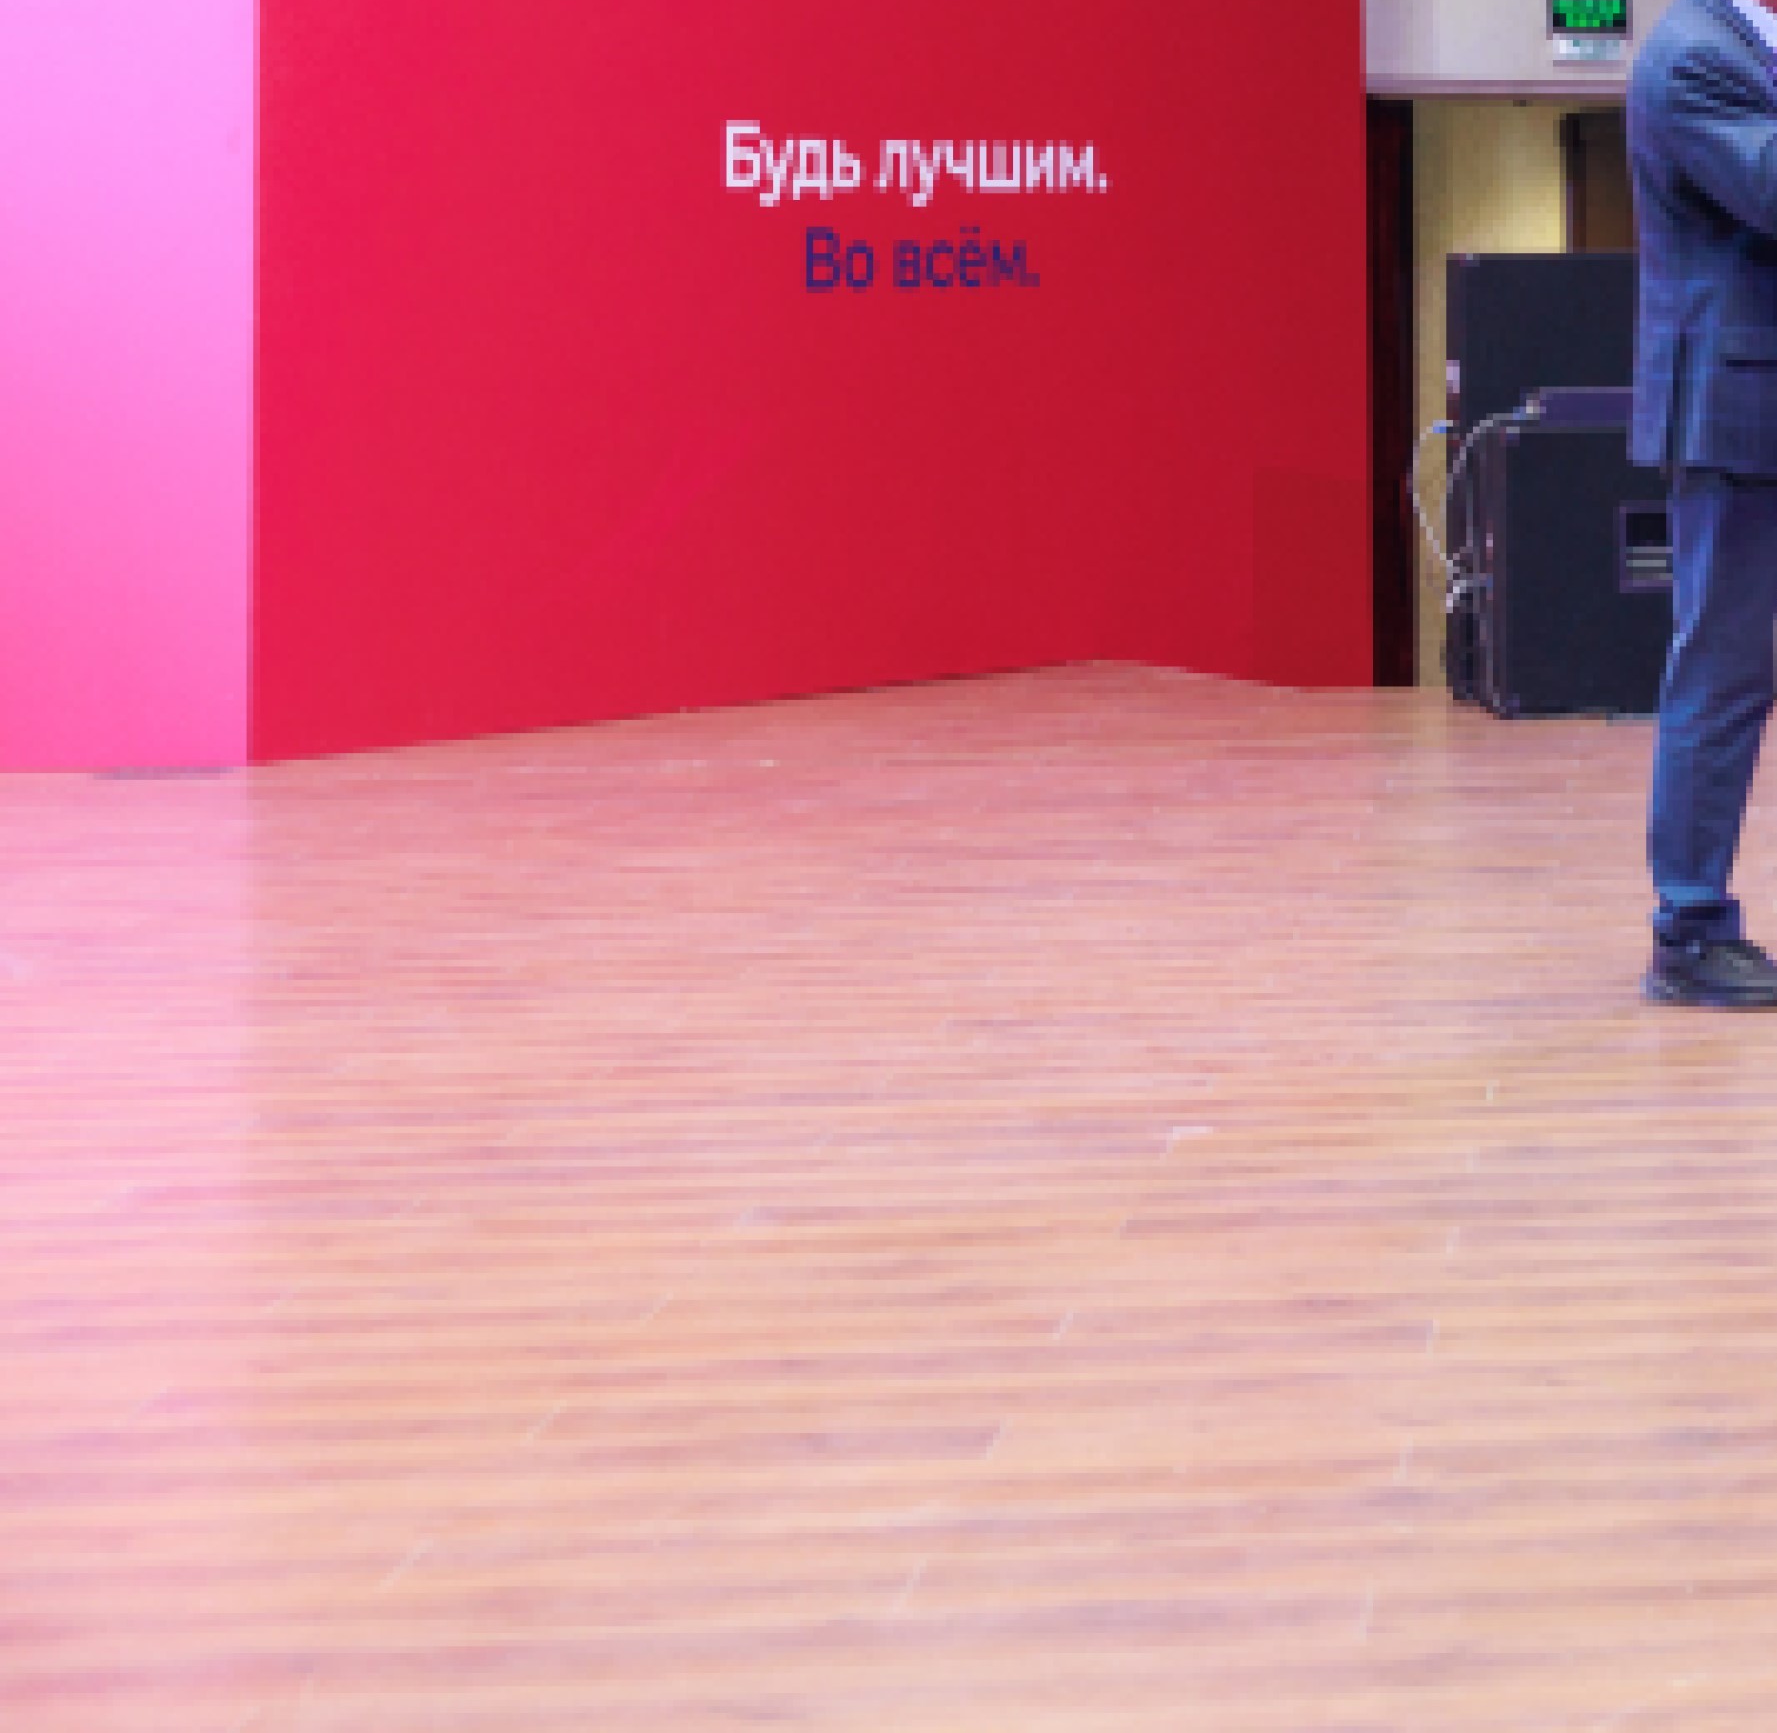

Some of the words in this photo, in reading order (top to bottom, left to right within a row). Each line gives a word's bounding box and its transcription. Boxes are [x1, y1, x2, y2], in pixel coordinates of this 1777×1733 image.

[722, 120, 865, 207] Будь
[873, 137, 1112, 207] лучшим.
[806, 226, 878, 293] Во
[893, 223, 1040, 292] всём.
